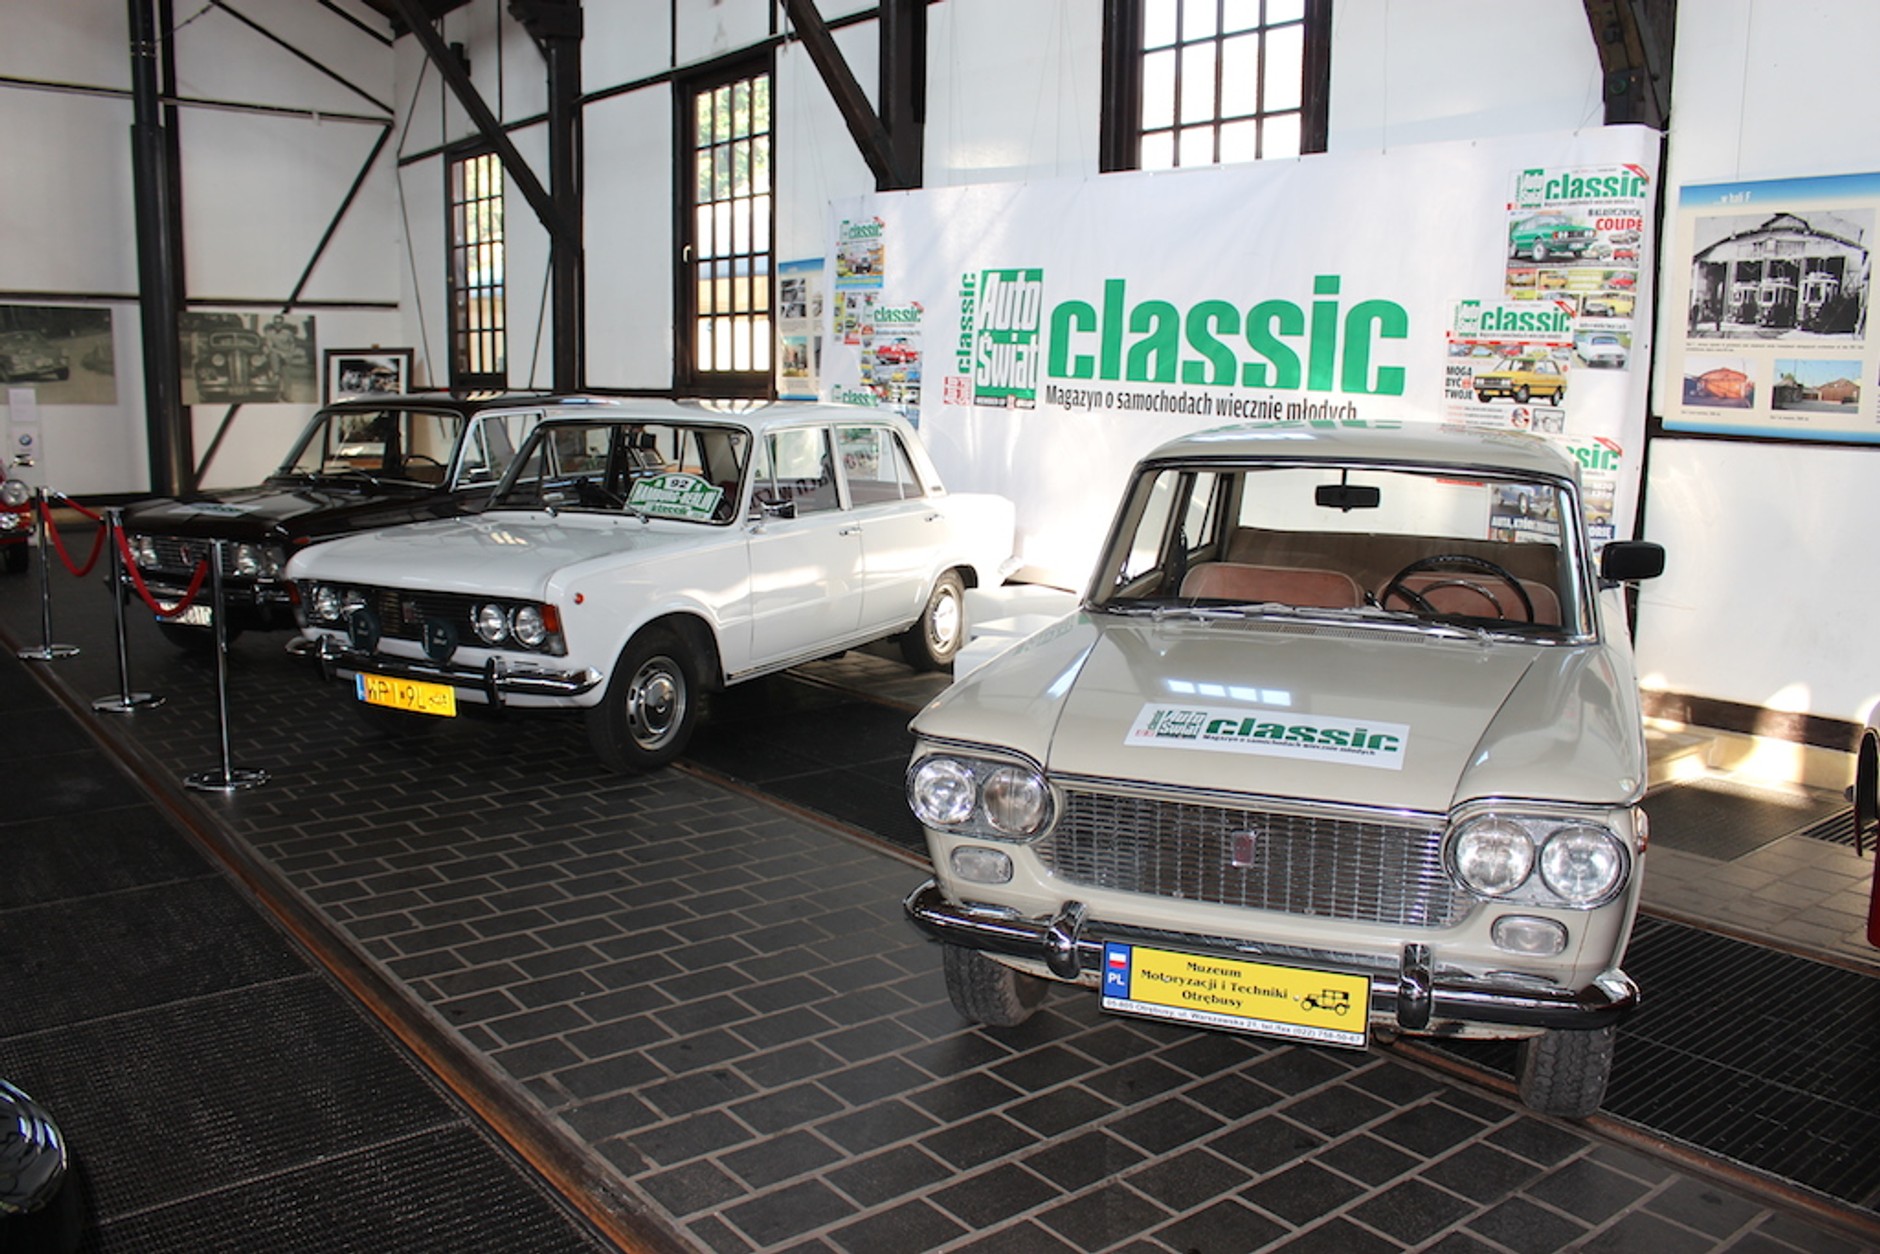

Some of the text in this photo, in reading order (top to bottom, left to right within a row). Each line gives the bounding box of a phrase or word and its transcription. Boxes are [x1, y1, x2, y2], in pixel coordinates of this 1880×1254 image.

[1545, 171, 1646, 199] classic
[848, 223, 883, 239] classic
[978, 271, 1041, 331] Auto
[874, 306, 921, 323] classic
[956, 273, 975, 373] classic
[1480, 307, 1570, 332] classic
[1048, 274, 1409, 396] classic
[976, 331, 1039, 389] Świat
[1046, 385, 1103, 411] Magazyn
[1105, 395, 1114, 408] o
[1116, 389, 1213, 417] samochodach
[1215, 394, 1283, 420] wiecznie
[1286, 399, 1357, 420] młodych
[670, 479, 689, 488] 92
[1205, 717, 1400, 752] classic
[1107, 973, 1125, 986] PL
[1187, 961, 1242, 978] Muzeum
[1141, 968, 1288, 999] Motoryzacji i Techniki
[1181, 989, 1243, 1008] Otrębusy
[1191, 1012, 1244, 1026] Warszawska
[1293, 1026, 1316, 1037] (022)
